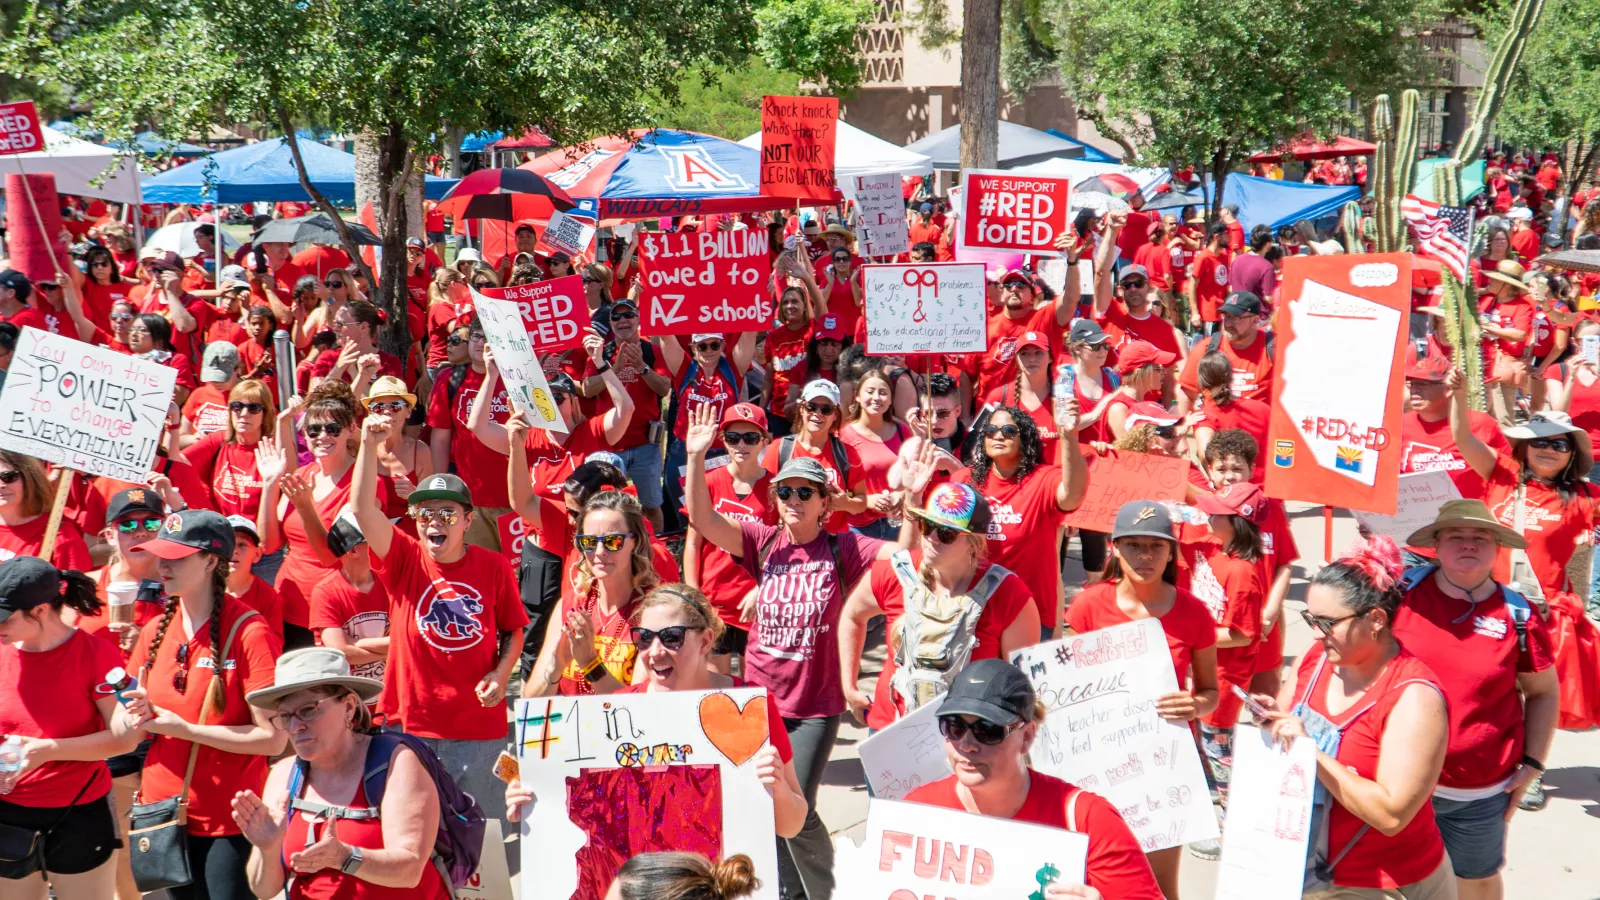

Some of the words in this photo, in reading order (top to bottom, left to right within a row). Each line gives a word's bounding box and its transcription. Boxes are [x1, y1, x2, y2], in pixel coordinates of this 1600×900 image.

[765, 102, 798, 117] Knock
[763, 121, 790, 136] Who's
[792, 121, 829, 139] there?
[764, 143, 792, 164] NOT
[797, 145, 822, 164] OUR
[980, 180, 999, 190] WE
[1002, 180, 1057, 193] SUPPORT
[608, 199, 703, 214] WILDCATS
[979, 192, 1055, 220] #RED
[644, 234, 693, 261] $1.1
[698, 229, 769, 261] BILLION
[977, 218, 1053, 246] forED
[649, 261, 715, 287] owed
[727, 262, 760, 285] to
[903, 268, 938, 298] 99
[504, 289, 518, 300] We
[519, 283, 552, 299] Support
[517, 294, 573, 323] RED
[650, 294, 688, 327] AZ
[698, 293, 773, 323] schools
[527, 318, 579, 347] rED
[895, 325, 948, 337] educational
[951, 324, 981, 341] funding
[912, 340, 931, 351] most
[30, 331, 66, 363] You
[80, 355, 113, 375] own
[124, 361, 159, 387] the
[38, 364, 138, 422] POWER
[30, 391, 52, 412] to
[70, 402, 133, 438] change
[1412, 452, 1455, 463] ARIZONA
[789, 563, 801, 574] MY
[758, 571, 837, 604] YOUNG
[1037, 671, 1128, 707] Because
[603, 702, 645, 741] in
[1068, 709, 1115, 733] teacher
[1124, 699, 1156, 717] deser
[1051, 751, 1064, 766] to
[1072, 737, 1092, 757] feel
[1101, 718, 1161, 748] supported!
[879, 830, 994, 886] FUND
